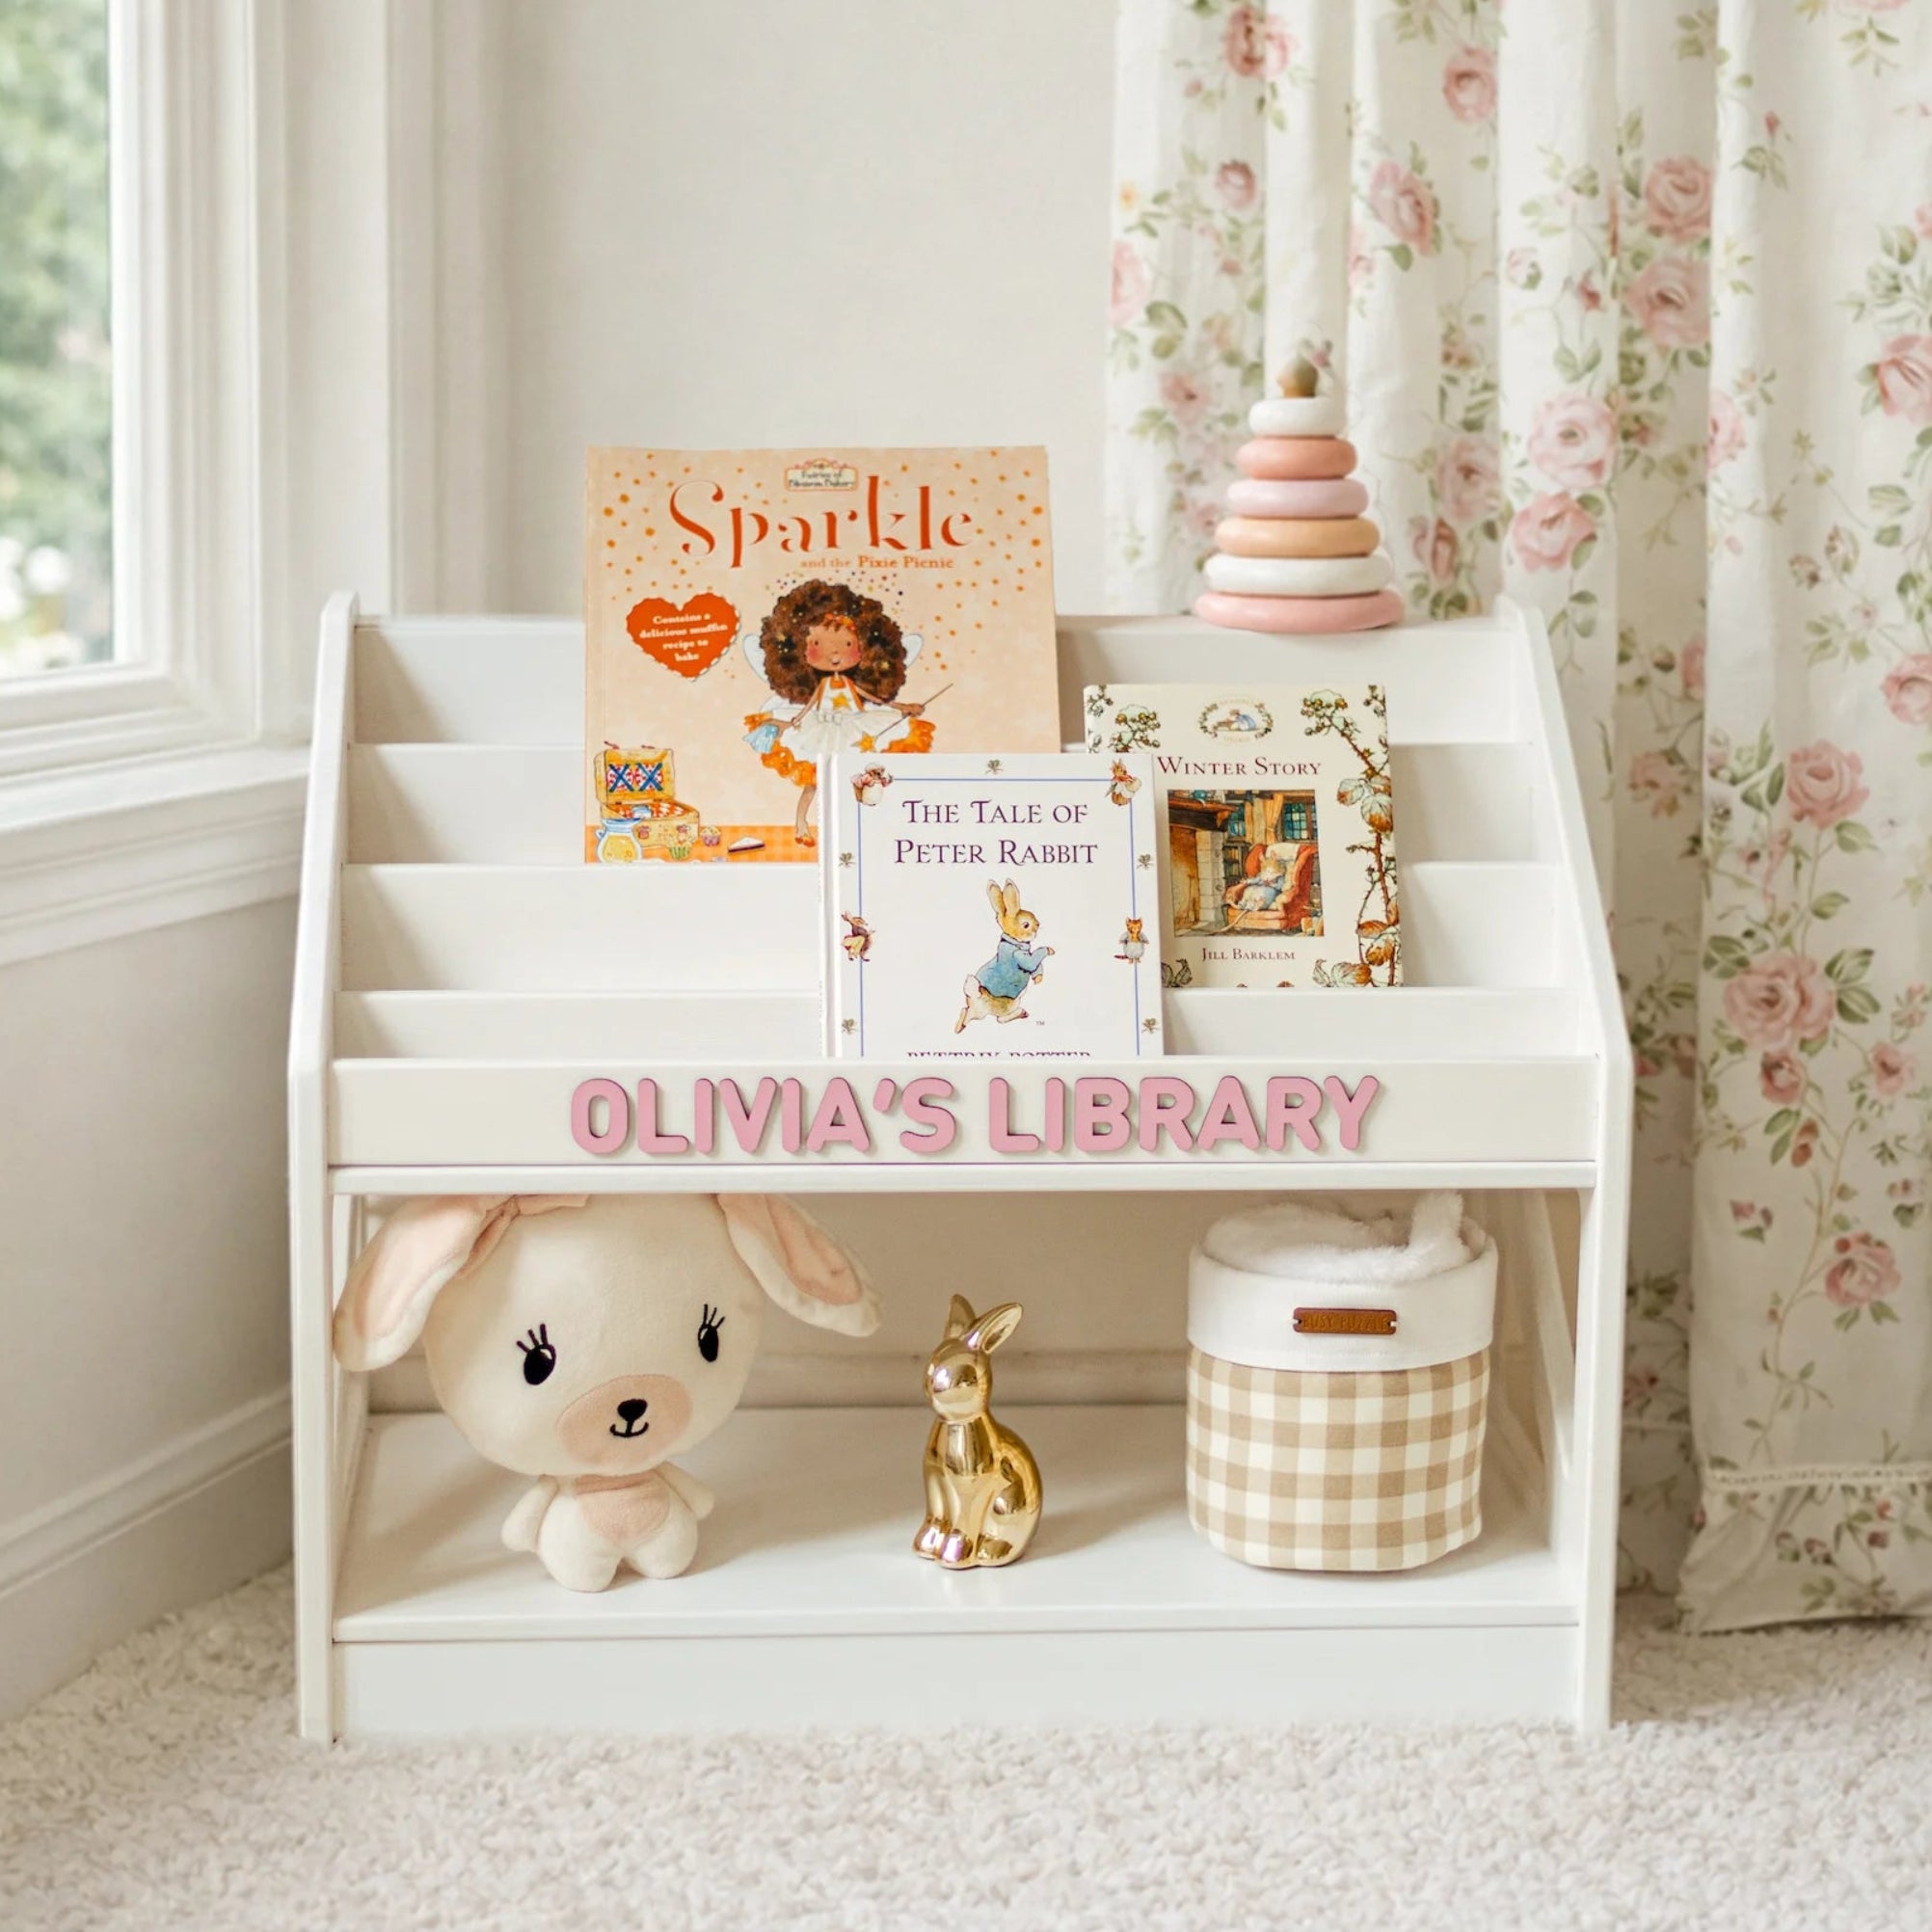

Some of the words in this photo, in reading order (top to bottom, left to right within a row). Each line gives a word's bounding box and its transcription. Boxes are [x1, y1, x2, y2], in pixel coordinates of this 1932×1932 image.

[669, 475, 972, 568] Sparkle
[800, 557, 826, 568] and
[830, 557, 850, 568] the
[858, 554, 898, 569] Pixie
[903, 554, 954, 569] Picnic
[653, 614, 702, 625] Contains
[639, 628, 687, 638] delicious
[689, 622, 728, 634] muffin
[662, 640, 695, 651] recipe
[675, 652, 700, 661] bake
[1157, 756, 1248, 775] WINTER
[1254, 756, 1322, 775] STORY
[901, 799, 960, 823] THE
[970, 799, 1043, 823] TALE
[1052, 804, 1088, 824] OF
[894, 839, 987, 864] PETER
[998, 839, 1098, 867] RABBIT
[1201, 948, 1229, 962] JILL
[1233, 948, 1296, 960] BARKLEM
[570, 1077, 957, 1155] OLIVIA'S
[989, 1075, 1381, 1154] LIBRARY
